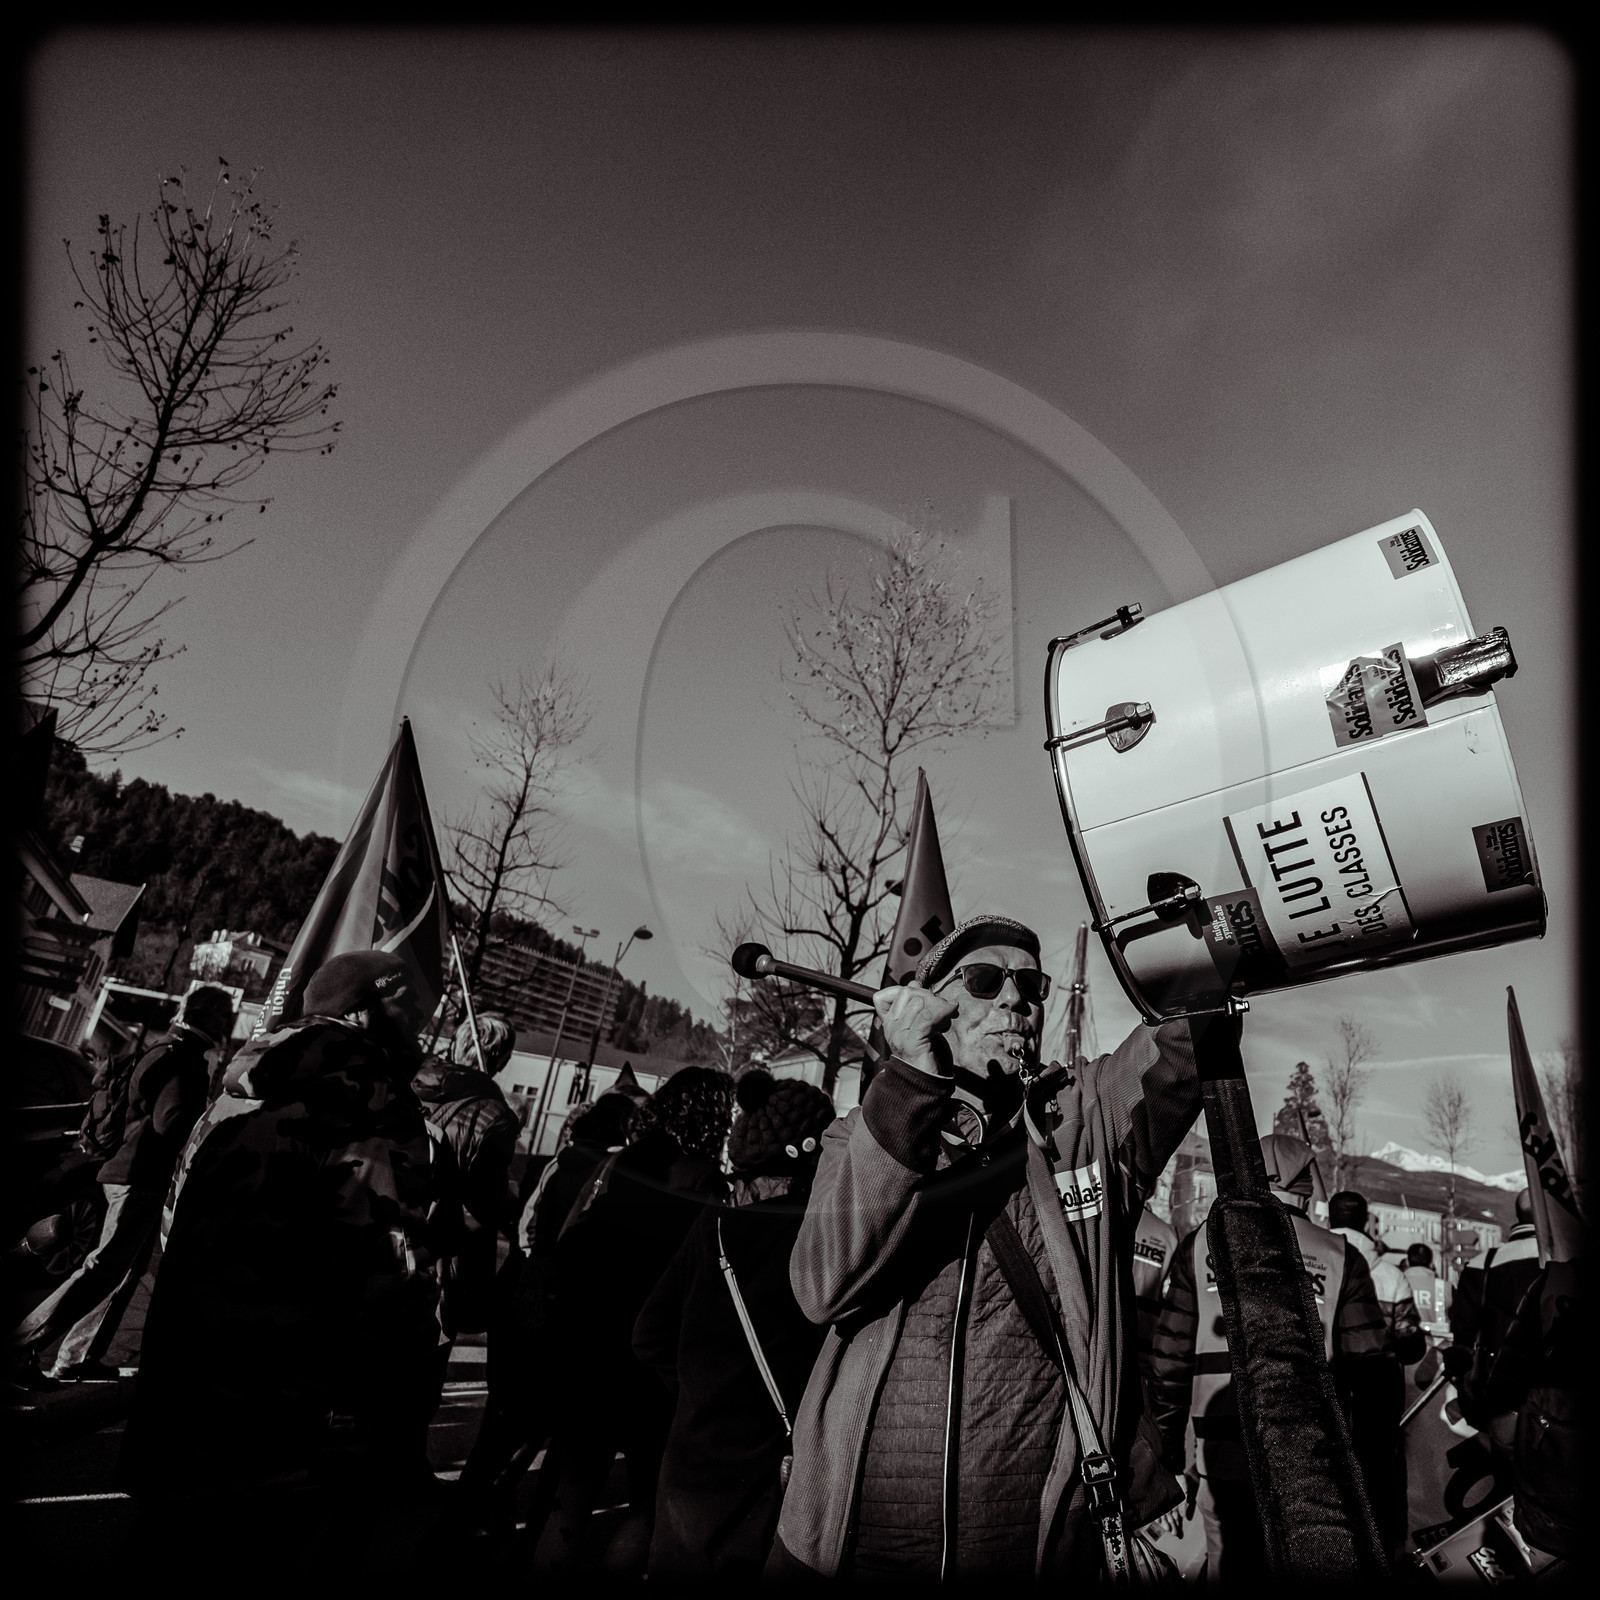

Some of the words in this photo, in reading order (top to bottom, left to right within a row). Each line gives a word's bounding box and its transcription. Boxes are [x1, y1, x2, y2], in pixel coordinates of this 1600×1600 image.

[1257, 810, 1332, 920] LUTTE
[1320, 805, 1374, 899] CLASSES
[1213, 918, 1225, 942] Union
[1214, 904, 1233, 940] syndicale
[1354, 903, 1388, 935] DES
[1297, 922, 1348, 953] JE
[272, 967, 292, 1015] Union
